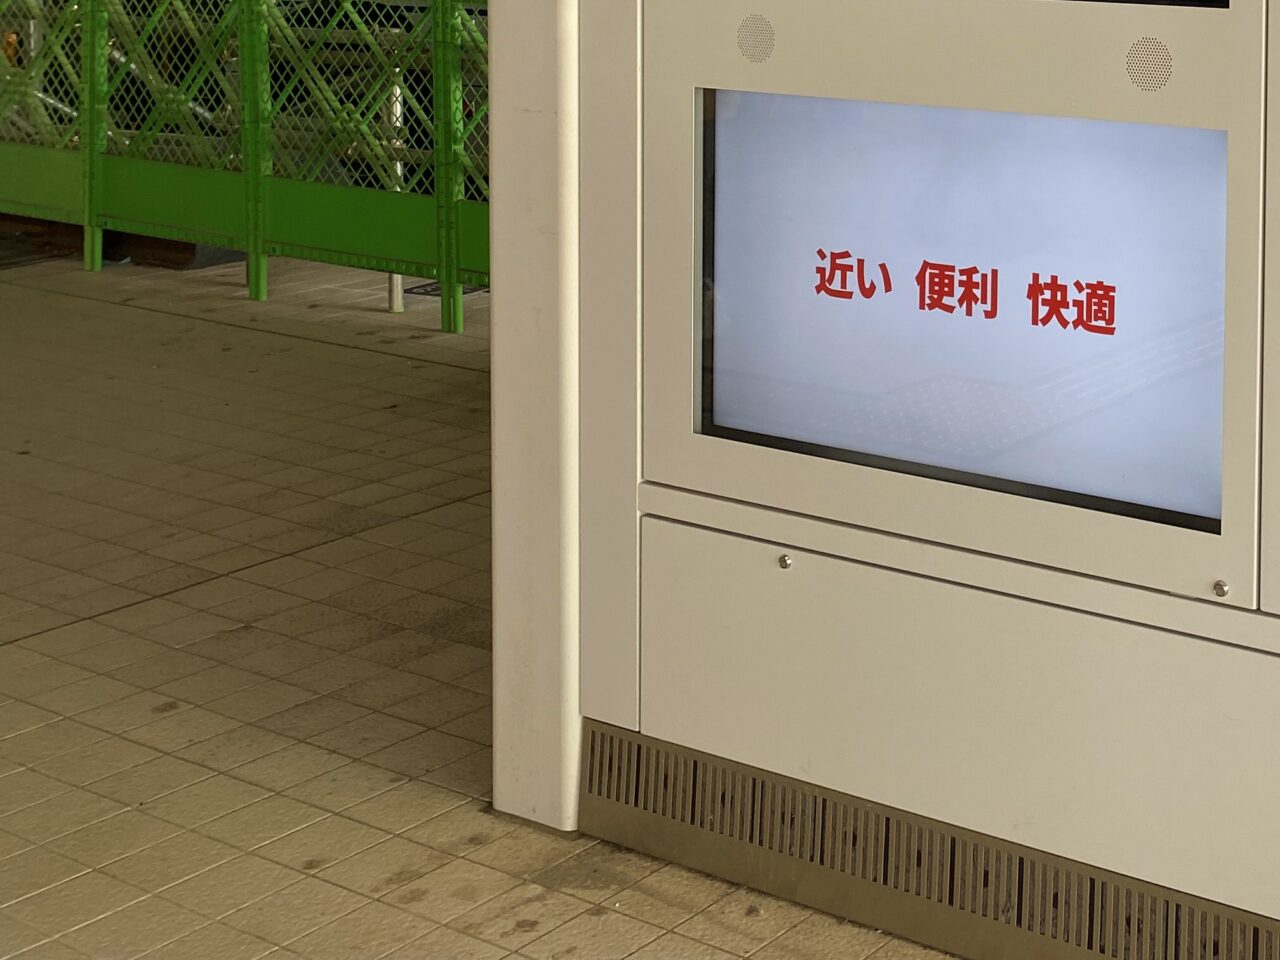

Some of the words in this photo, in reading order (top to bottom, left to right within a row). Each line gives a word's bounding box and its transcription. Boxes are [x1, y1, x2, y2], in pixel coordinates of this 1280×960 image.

[814, 248, 892, 300] 近い
[915, 259, 999, 319] 便利
[1026, 273, 1117, 336] 快適
